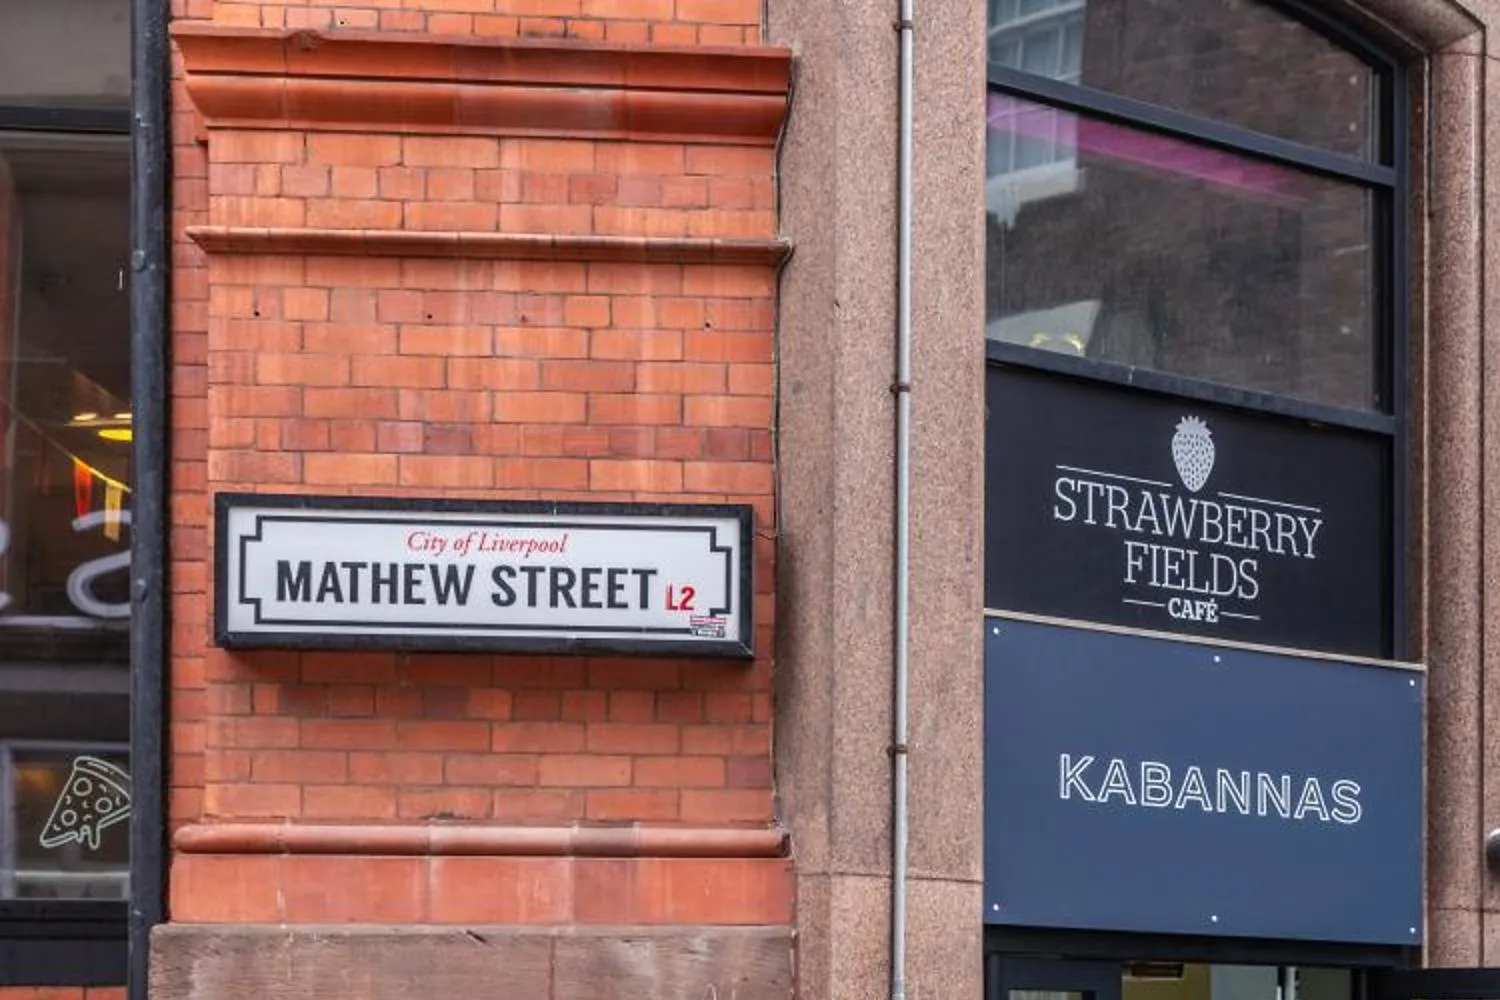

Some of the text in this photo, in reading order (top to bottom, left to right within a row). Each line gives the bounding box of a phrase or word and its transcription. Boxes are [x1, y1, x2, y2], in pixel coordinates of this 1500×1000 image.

[1054, 476, 1323, 559] STRAWBERRY
[407, 531, 569, 556] City of Liverpool
[276, 559, 658, 609] MATHEW STREET
[1123, 540, 1260, 600] FIELDS
[665, 584, 695, 611] L2
[1167, 598, 1219, 623] CAFÉ
[1059, 753, 1363, 824] KABANNAS
